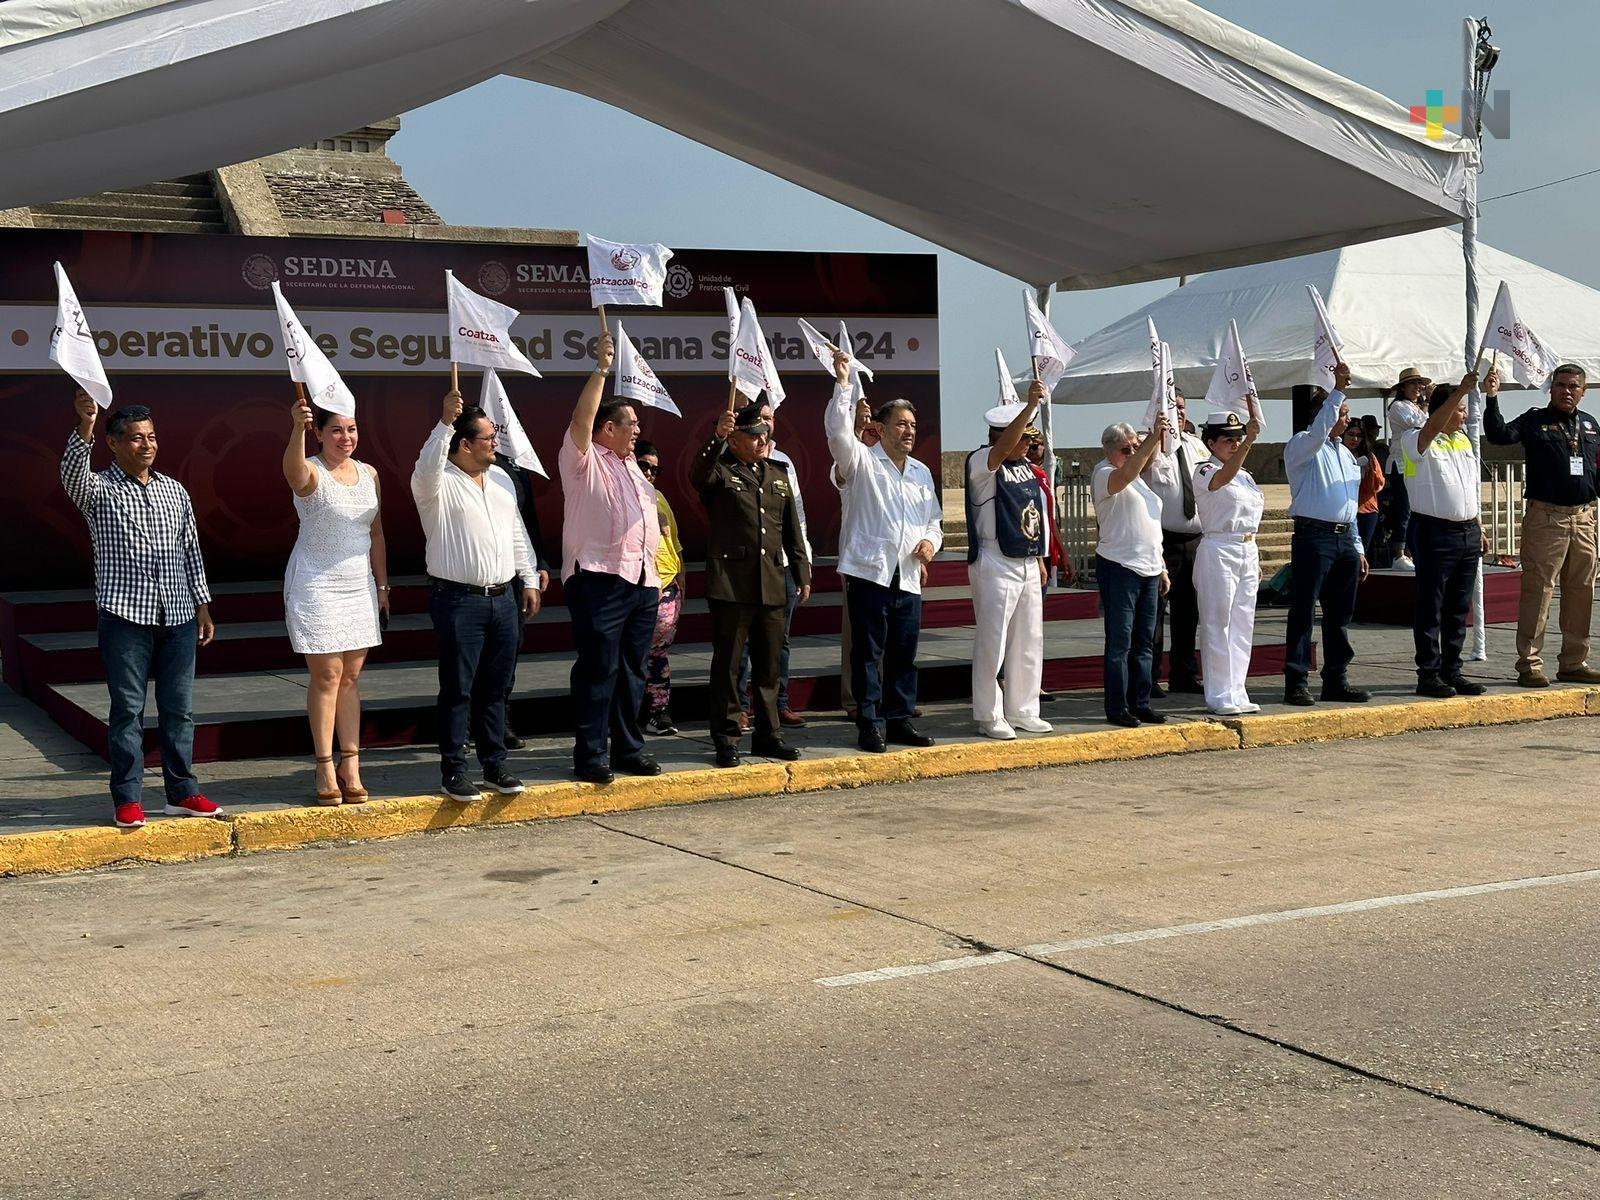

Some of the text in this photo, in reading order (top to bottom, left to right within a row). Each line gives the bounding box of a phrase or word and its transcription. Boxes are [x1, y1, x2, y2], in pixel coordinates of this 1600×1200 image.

[284, 256, 397, 278] SEDENA
[516, 264, 589, 283] SEMA
[698, 274, 723, 282] Unidad
[735, 284, 750, 292] Civil
[92, 324, 274, 359] perativo
